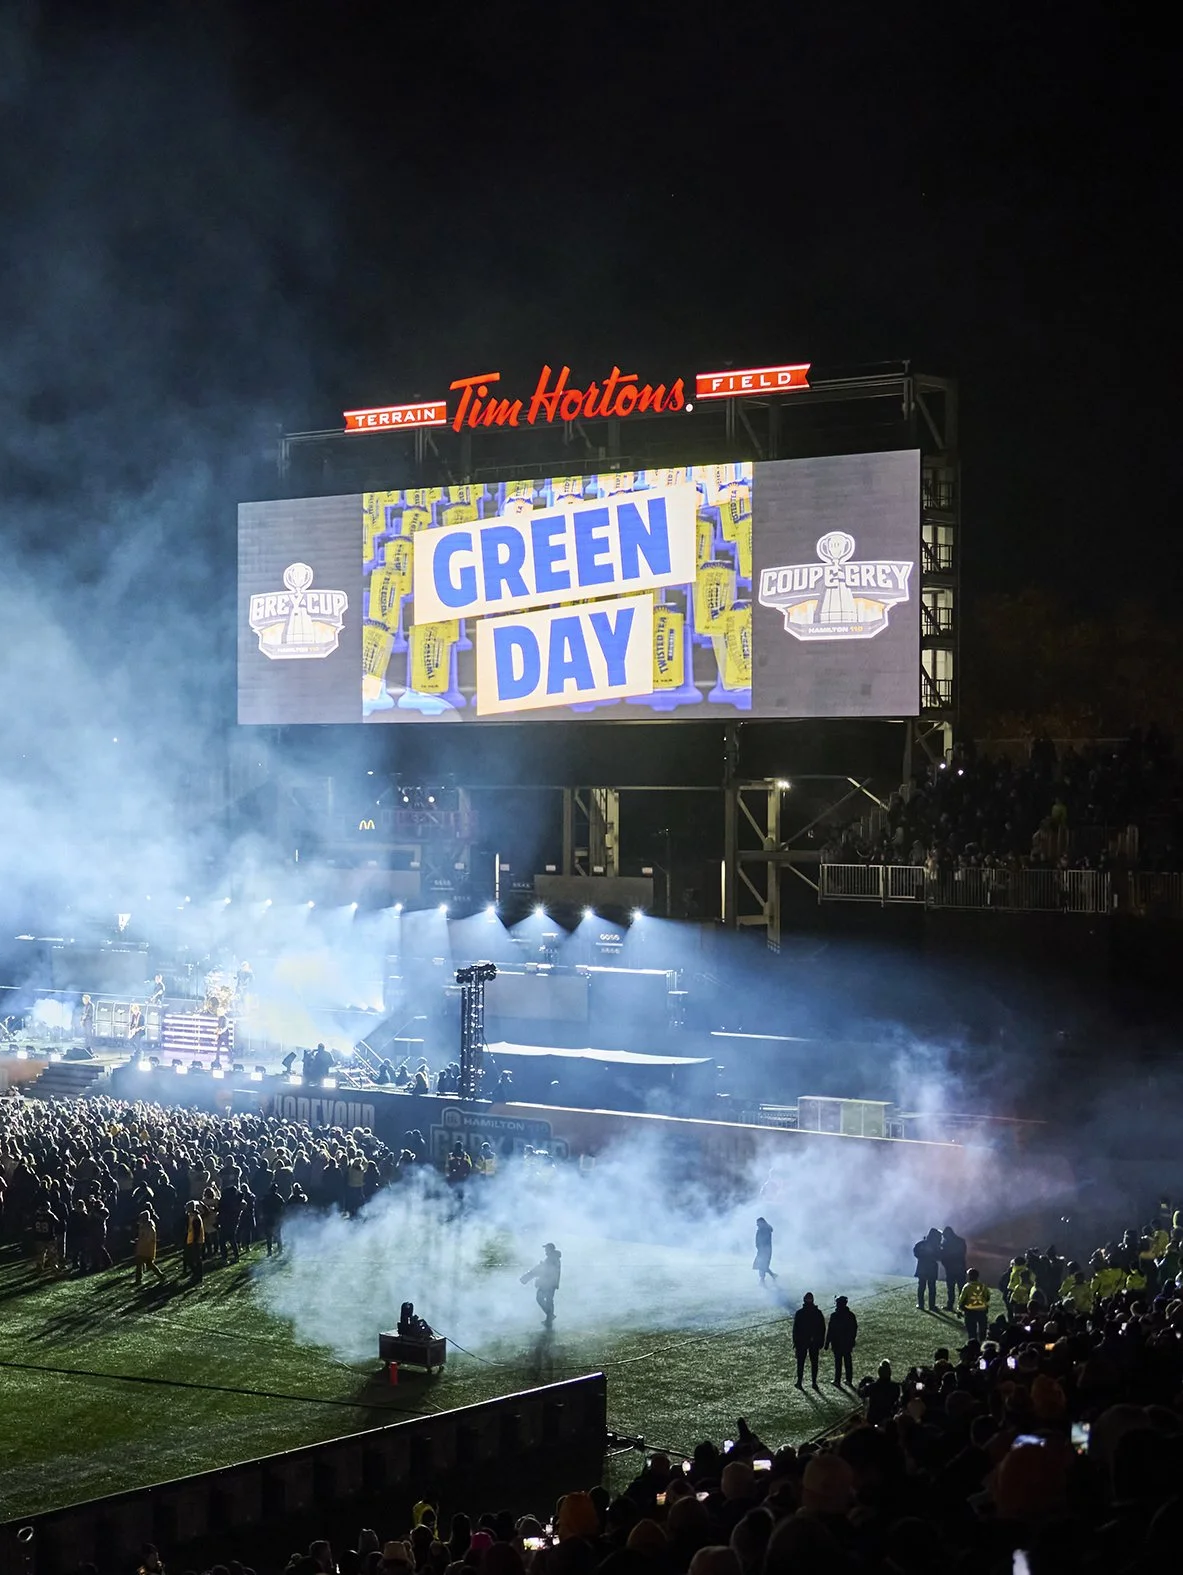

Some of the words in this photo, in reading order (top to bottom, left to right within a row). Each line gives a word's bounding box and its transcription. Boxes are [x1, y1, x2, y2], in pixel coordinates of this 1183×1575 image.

[712, 372, 791, 392] FIELD
[450, 372, 520, 432] Tim
[527, 364, 685, 425] Hortons
[355, 406, 437, 428] TERRAIN
[433, 497, 671, 608] GREEN
[762, 565, 840, 596] COUPE
[845, 564, 909, 590] GREY
[252, 593, 303, 620] GREY
[307, 593, 346, 617] CUP
[657, 617, 667, 633] TEA
[493, 607, 635, 700] DAY
[656, 635, 669, 674] TWISTED
[464, 1117, 524, 1131] HAMILTON
